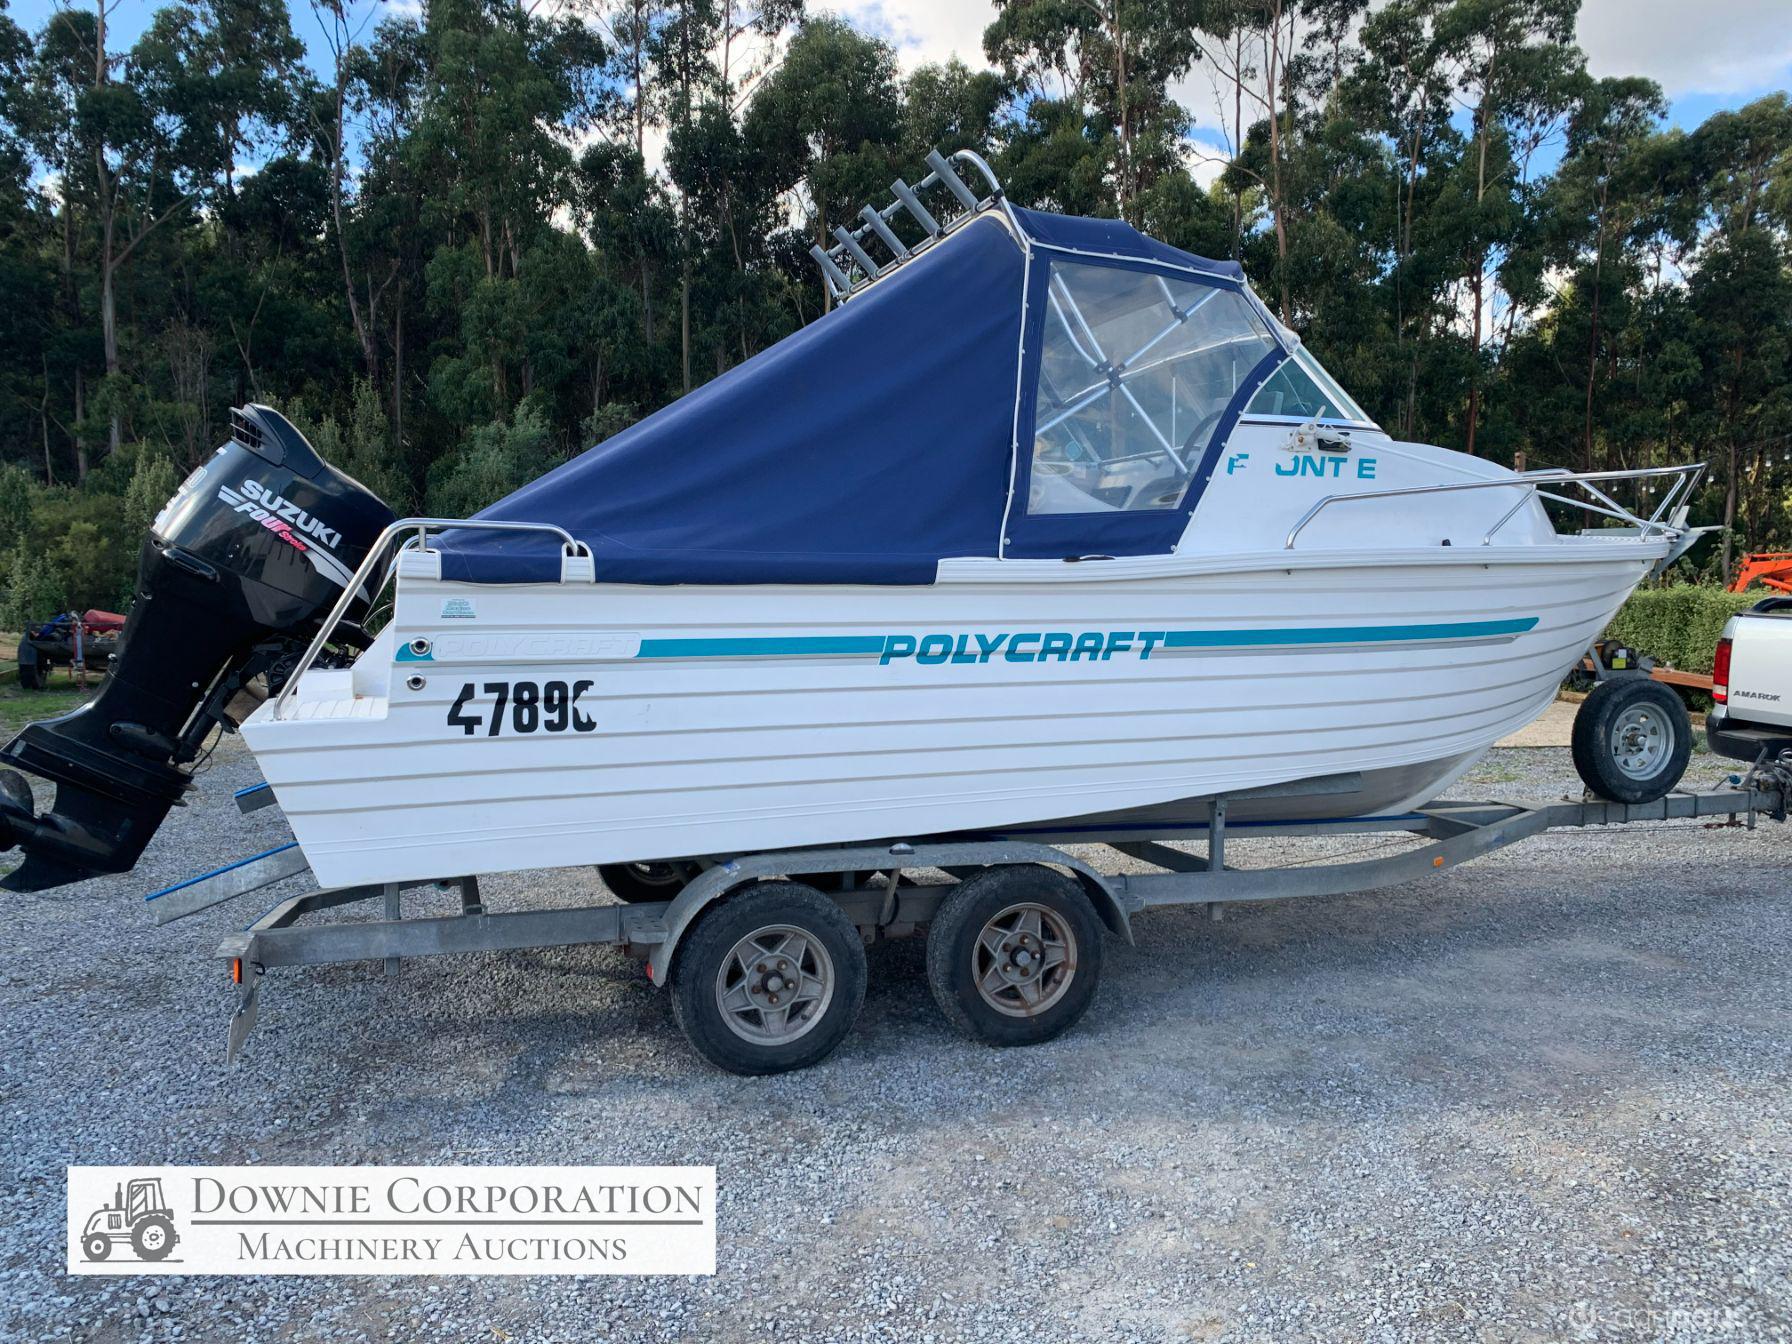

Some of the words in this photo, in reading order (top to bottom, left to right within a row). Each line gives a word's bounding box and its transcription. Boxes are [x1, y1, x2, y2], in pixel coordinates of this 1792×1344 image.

[240, 479, 343, 550] SUZUKI
[878, 631, 1166, 666] POLYCRAFT
[1733, 690, 1781, 702] AMAROK
